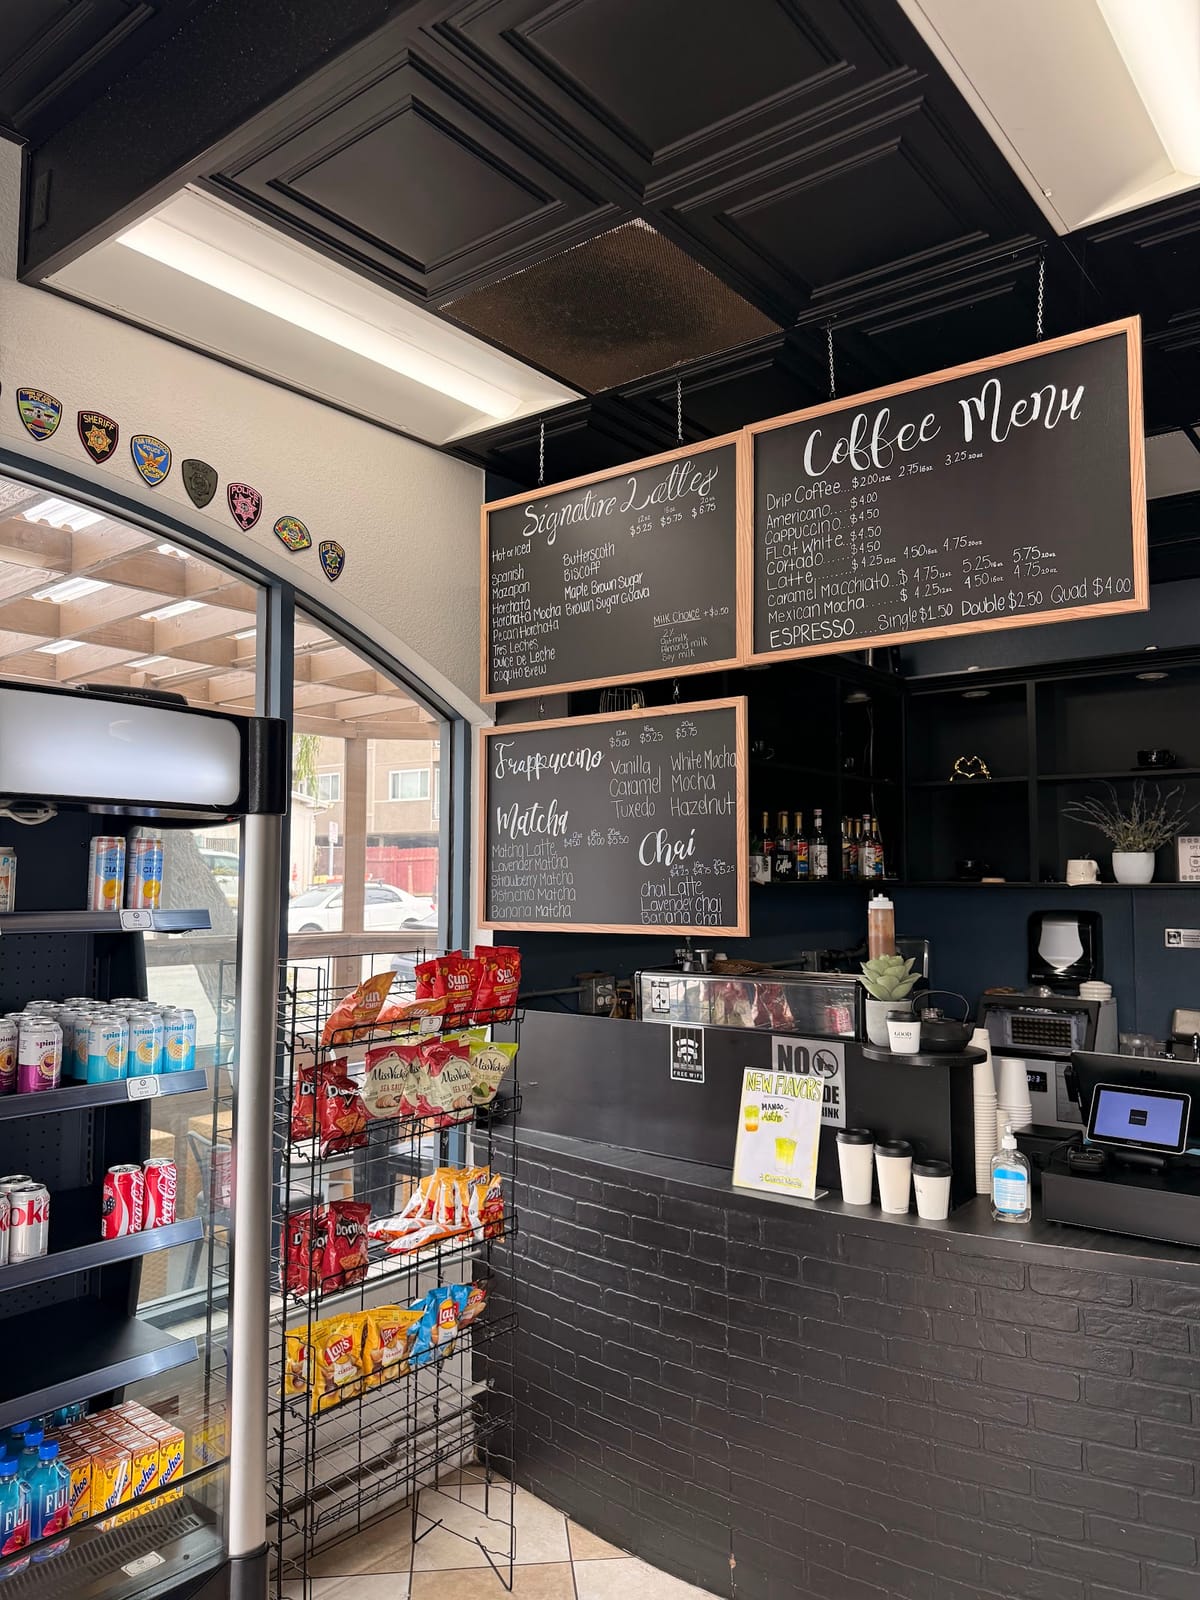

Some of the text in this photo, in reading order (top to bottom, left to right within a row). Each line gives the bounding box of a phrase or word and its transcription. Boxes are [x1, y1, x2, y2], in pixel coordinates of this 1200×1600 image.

[82, 414, 115, 431] SHERIFF
[804, 378, 1085, 478] Coffee Menu
[766, 492, 792, 511] Drip
[794, 481, 841, 504] Coffee
[852, 473, 879, 489] $2.00
[898, 462, 919, 478] 2.75
[945, 450, 967, 465] 3.25
[231, 486, 260, 504] POLICE
[522, 460, 719, 545] Signature Lattes
[766, 491, 878, 530] Americano $4.00
[629, 522, 653, 537] $5.25
[660, 512, 683, 527] $5.75
[765, 508, 880, 546] Cappuccino $4.50
[850, 525, 882, 543] $4.50
[492, 539, 531, 563] Hot or Iced
[766, 540, 881, 576] Cortado $4.50
[767, 571, 813, 591] Latte
[851, 554, 883, 571] $4.25
[903, 544, 926, 559] 4.50
[943, 535, 967, 551] 4.75
[491, 564, 525, 587] Spanish
[564, 572, 644, 601] Maple Brown Sugar
[767, 578, 817, 607] Caramel
[821, 571, 890, 598] Macchiato
[962, 554, 991, 573] 5.25
[1013, 545, 1041, 563] 5.75
[492, 581, 530, 600] Mazapan
[768, 603, 821, 625] Mexican
[823, 595, 866, 615] Mocha
[1013, 561, 1041, 579] 4.75
[492, 598, 531, 616] Horchata
[492, 602, 561, 629] Horchata Mocha
[565, 599, 595, 617] Brown
[596, 593, 620, 615] Sugar
[769, 576, 1132, 649] ESPRESSO Single $1.50 Double $2.50 Quad $4.00
[493, 619, 560, 643] Pecan Horchata
[493, 644, 507, 657] Tres
[529, 646, 556, 663] Leche
[676, 727, 698, 740] $5.75
[494, 740, 605, 782] Frappuccino
[610, 744, 737, 776] Vanilla White Mocha
[609, 765, 715, 798] Caramel Mocha
[611, 792, 736, 820] Tuxedo Hazelnut
[496, 798, 569, 840] Matcha
[492, 838, 555, 858] Matcha Latte
[638, 828, 696, 866] Chai
[491, 855, 569, 873] Lavender Matcha
[540, 870, 574, 886] Matcha
[668, 876, 704, 896] Latte
[537, 886, 576, 901] Matcha
[641, 894, 694, 911] Lavender
[491, 901, 572, 919] Banana Matcha
[641, 911, 691, 925] Banana
[448, 974, 468, 989] Sun
[777, 1044, 810, 1075] NO
[673, 1070, 688, 1078] FREE
[745, 1071, 774, 1094] NEW
[761, 1103, 784, 1111] MANGO
[327, 1337, 351, 1362] Lay's
[46, 1485, 69, 1514] FIJI
[5, 1505, 29, 1532] FIJI
